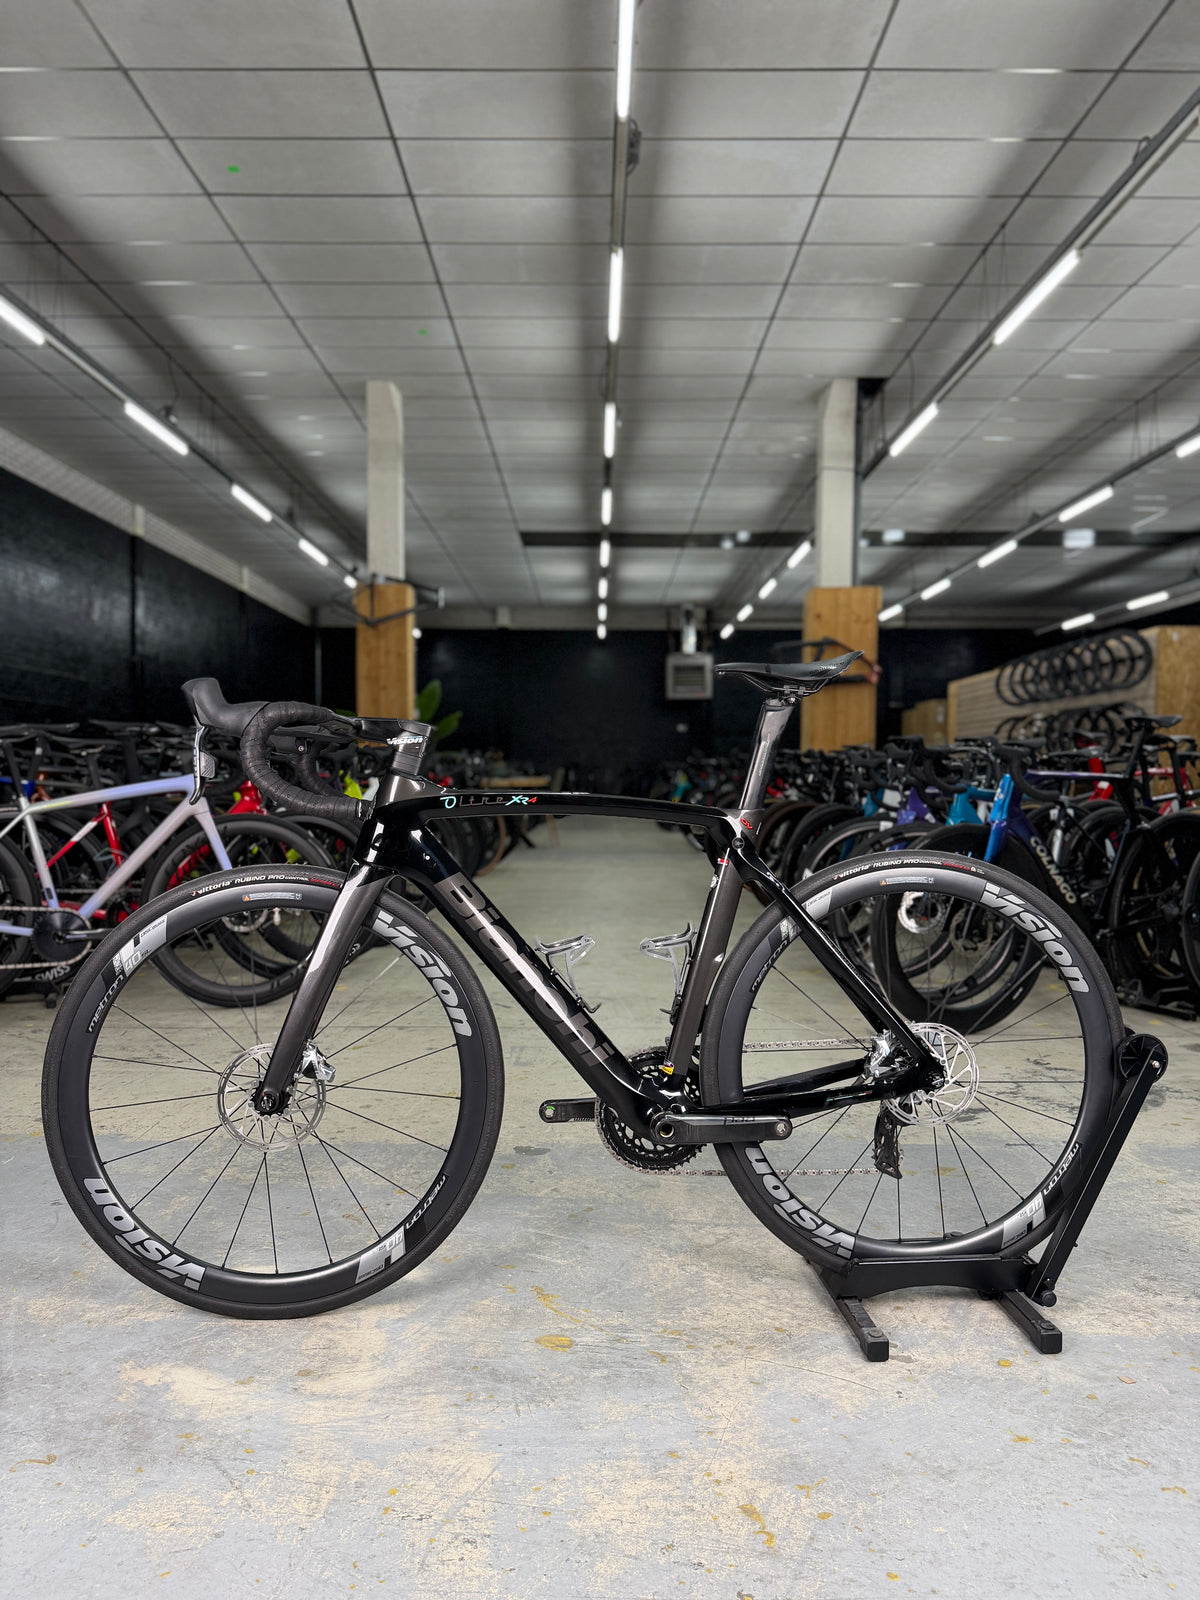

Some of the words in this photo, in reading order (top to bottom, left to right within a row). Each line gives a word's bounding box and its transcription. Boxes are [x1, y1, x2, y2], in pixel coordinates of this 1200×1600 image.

[386, 735, 423, 745] Vision
[235, 875, 266, 884] RUBINO
[873, 860, 902, 868] RUBINO
[1030, 836, 1077, 904] COLNAGO
[979, 882, 1090, 993] Vision
[372, 910, 473, 1037] Vision
[434, 872, 616, 1067] Bianchi
[88, 974, 124, 1032] metron
[1043, 1144, 1079, 1195] metron
[405, 1175, 446, 1229] metron
[745, 1147, 856, 1259] Vision
[83, 1178, 206, 1291] Vision
